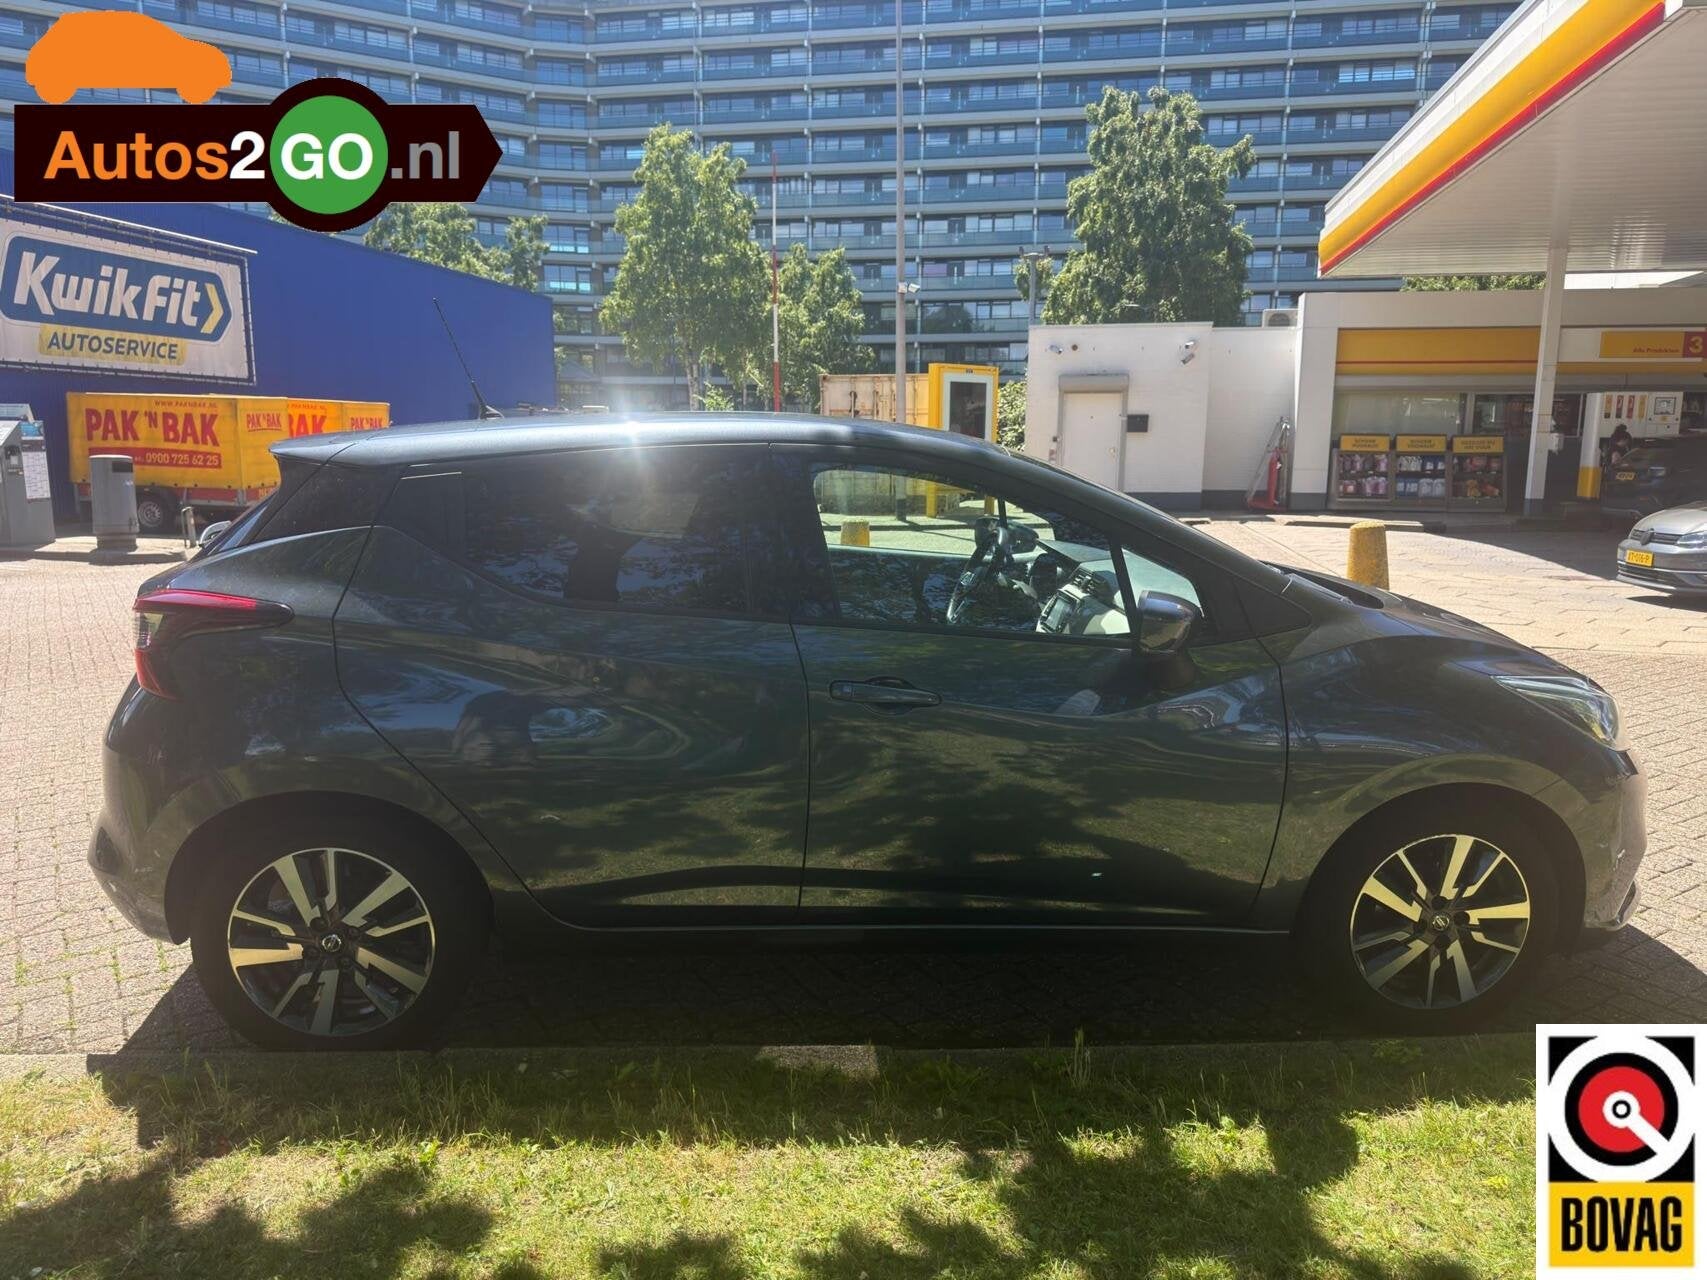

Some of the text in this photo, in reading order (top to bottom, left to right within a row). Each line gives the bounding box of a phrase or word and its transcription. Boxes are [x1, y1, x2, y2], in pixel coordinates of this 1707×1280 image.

[47, 331, 178, 360] AUTOSERVICE
[1689, 336, 1703, 353] 3
[85, 408, 140, 441] PAK
[162, 411, 220, 447] BAK
[246, 413, 262, 429] PAK
[267, 413, 282, 428] BAK
[145, 452, 170, 464] 0900
[172, 453, 190, 465] 725
[192, 455, 204, 465] 62
[206, 455, 219, 466] 25
